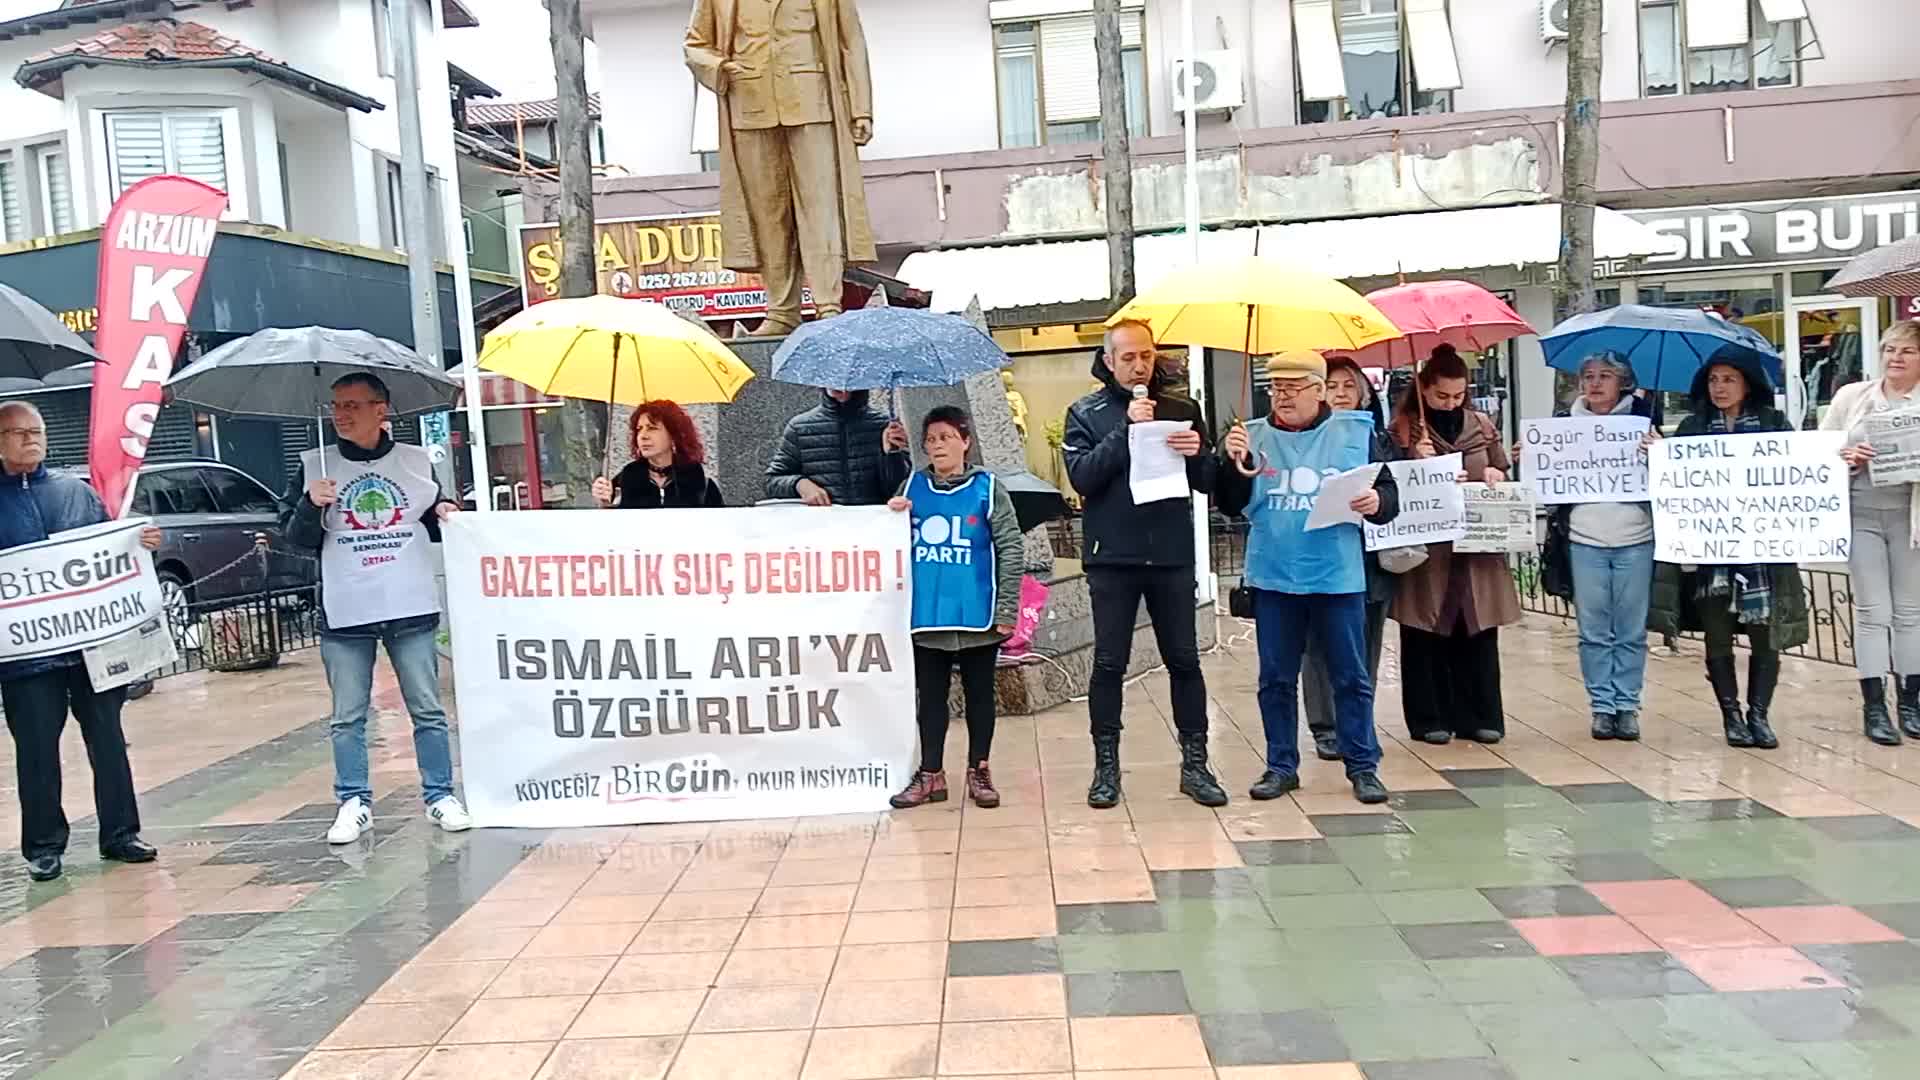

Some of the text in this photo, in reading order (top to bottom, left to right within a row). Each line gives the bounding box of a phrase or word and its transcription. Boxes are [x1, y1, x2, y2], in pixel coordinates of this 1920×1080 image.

[116, 210, 217, 258] ARZUM
[639, 270, 737, 290] 0252 262 20 23
[1526, 424, 1645, 452] Özgür Basın
[1752, 439, 1790, 457] ARI
[1407, 466, 1456, 487] Alma
[1659, 463, 1831, 489] ALİCAN ULUDAĞ
[1656, 494, 1840, 515] MERDAN YANARDAĞ
[1678, 516, 1821, 535] PINAR GAYIP
[480, 549, 664, 598] GAZETECİLİK
[673, 551, 734, 604] SUÇ
[9, 591, 147, 646] SUSMAYACAK
[496, 632, 893, 681] İSMAİL ARI'YA
[552, 685, 842, 739] ÖZGÜRLÜK
[515, 771, 601, 803] KÖYCEĞİZ
[747, 767, 795, 792] OKUR
[800, 762, 889, 791] İNSİYATİFİ
